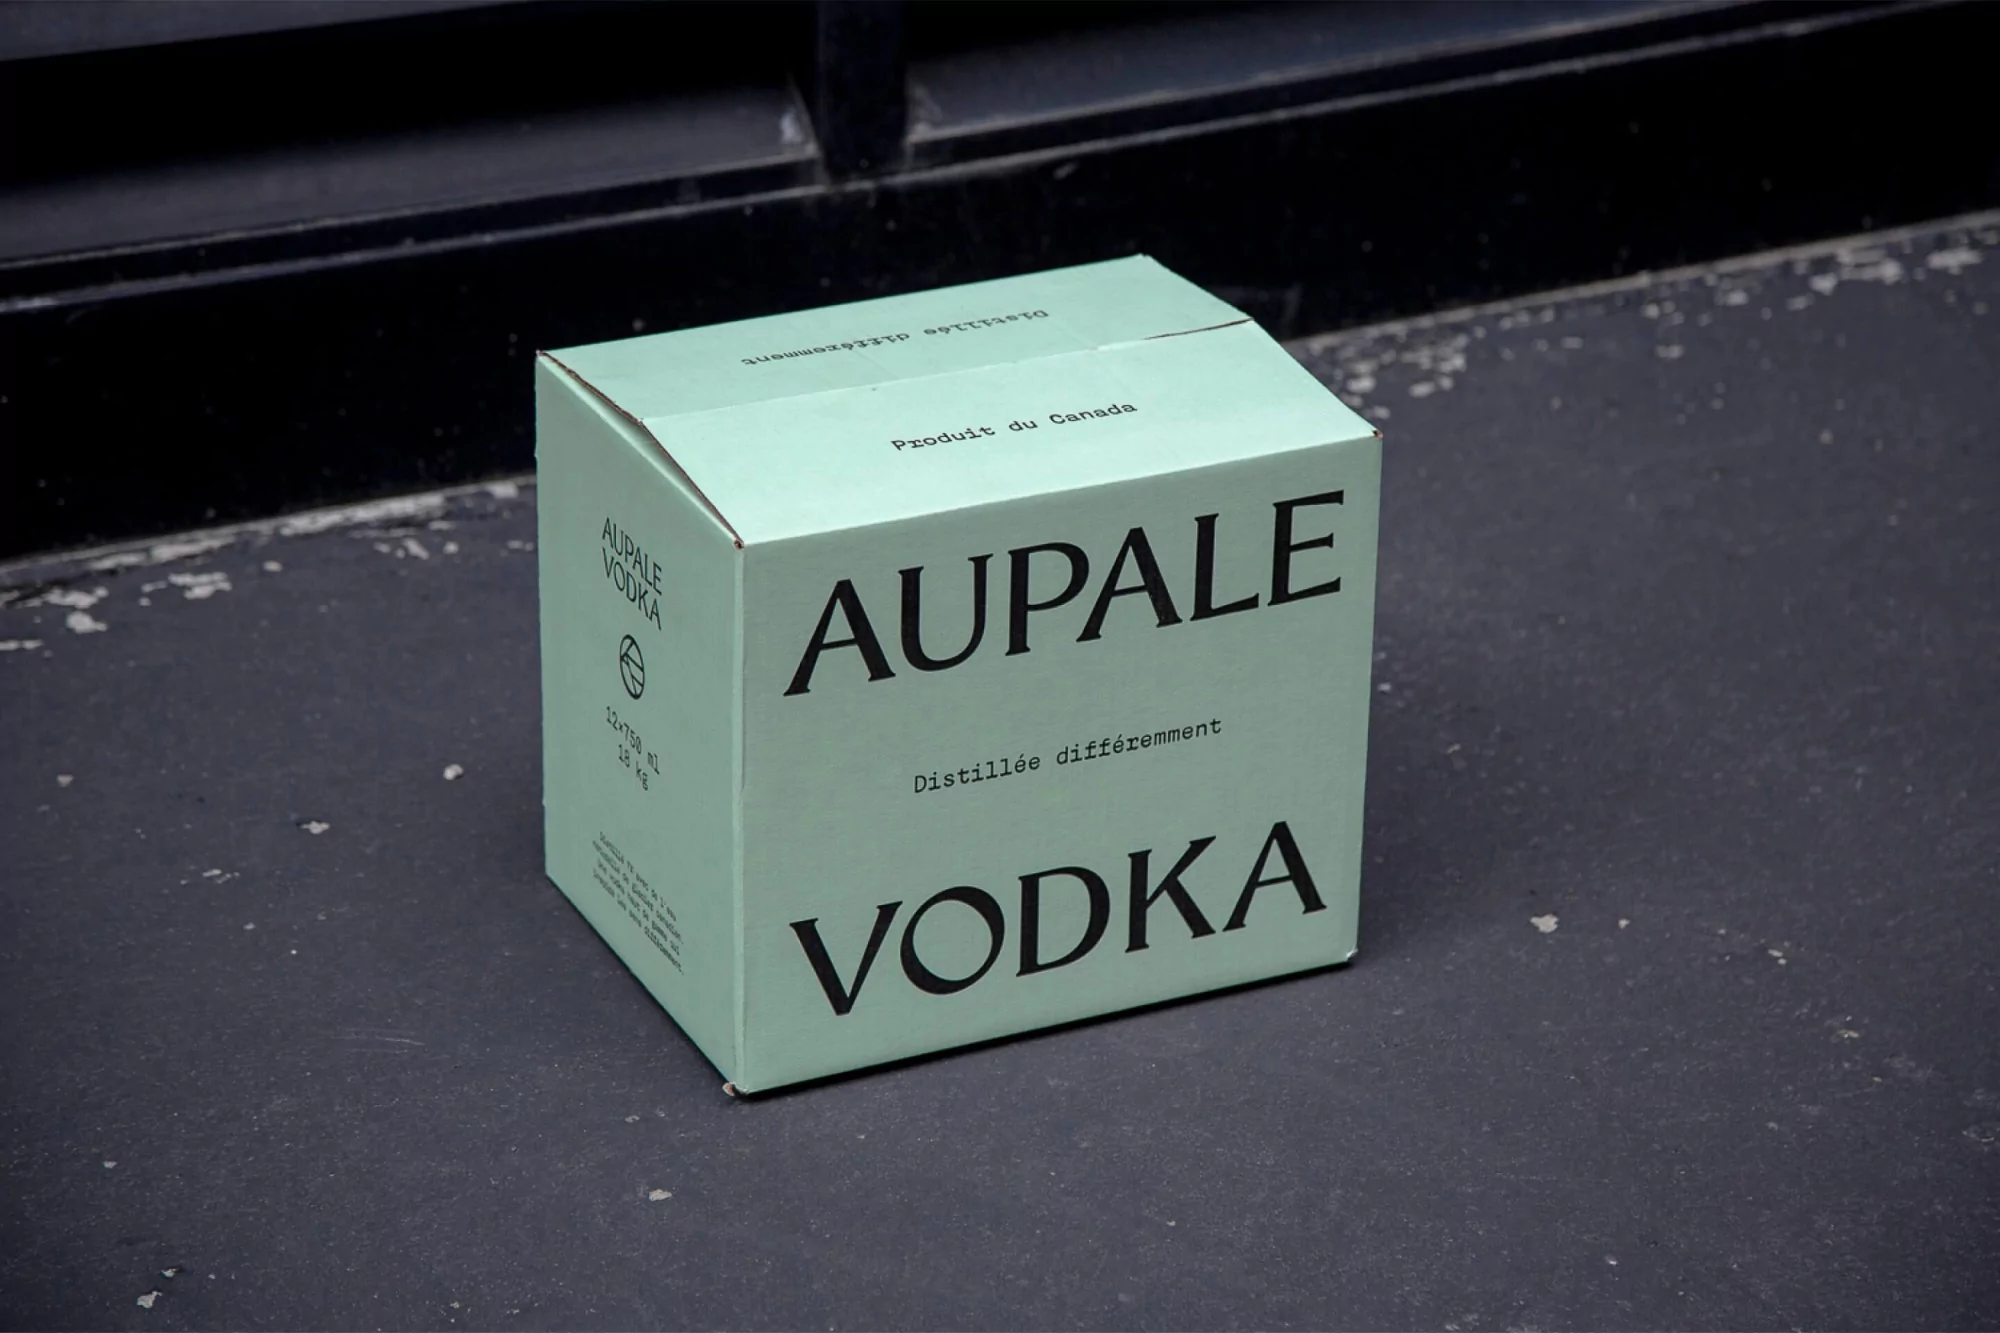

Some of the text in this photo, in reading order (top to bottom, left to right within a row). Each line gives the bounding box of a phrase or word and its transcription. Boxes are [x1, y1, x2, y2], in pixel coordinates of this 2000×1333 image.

[741, 309, 1049, 366] Distillée différemment
[891, 403, 1138, 451] Produit du Canada
[602, 516, 662, 597] AUPALE
[602, 546, 662, 631] VODKA
[783, 490, 1344, 696] AUPALE
[618, 744, 649, 791] 18 kg
[914, 718, 1222, 794] Distillée différemment
[789, 821, 1327, 1016] VODKA
